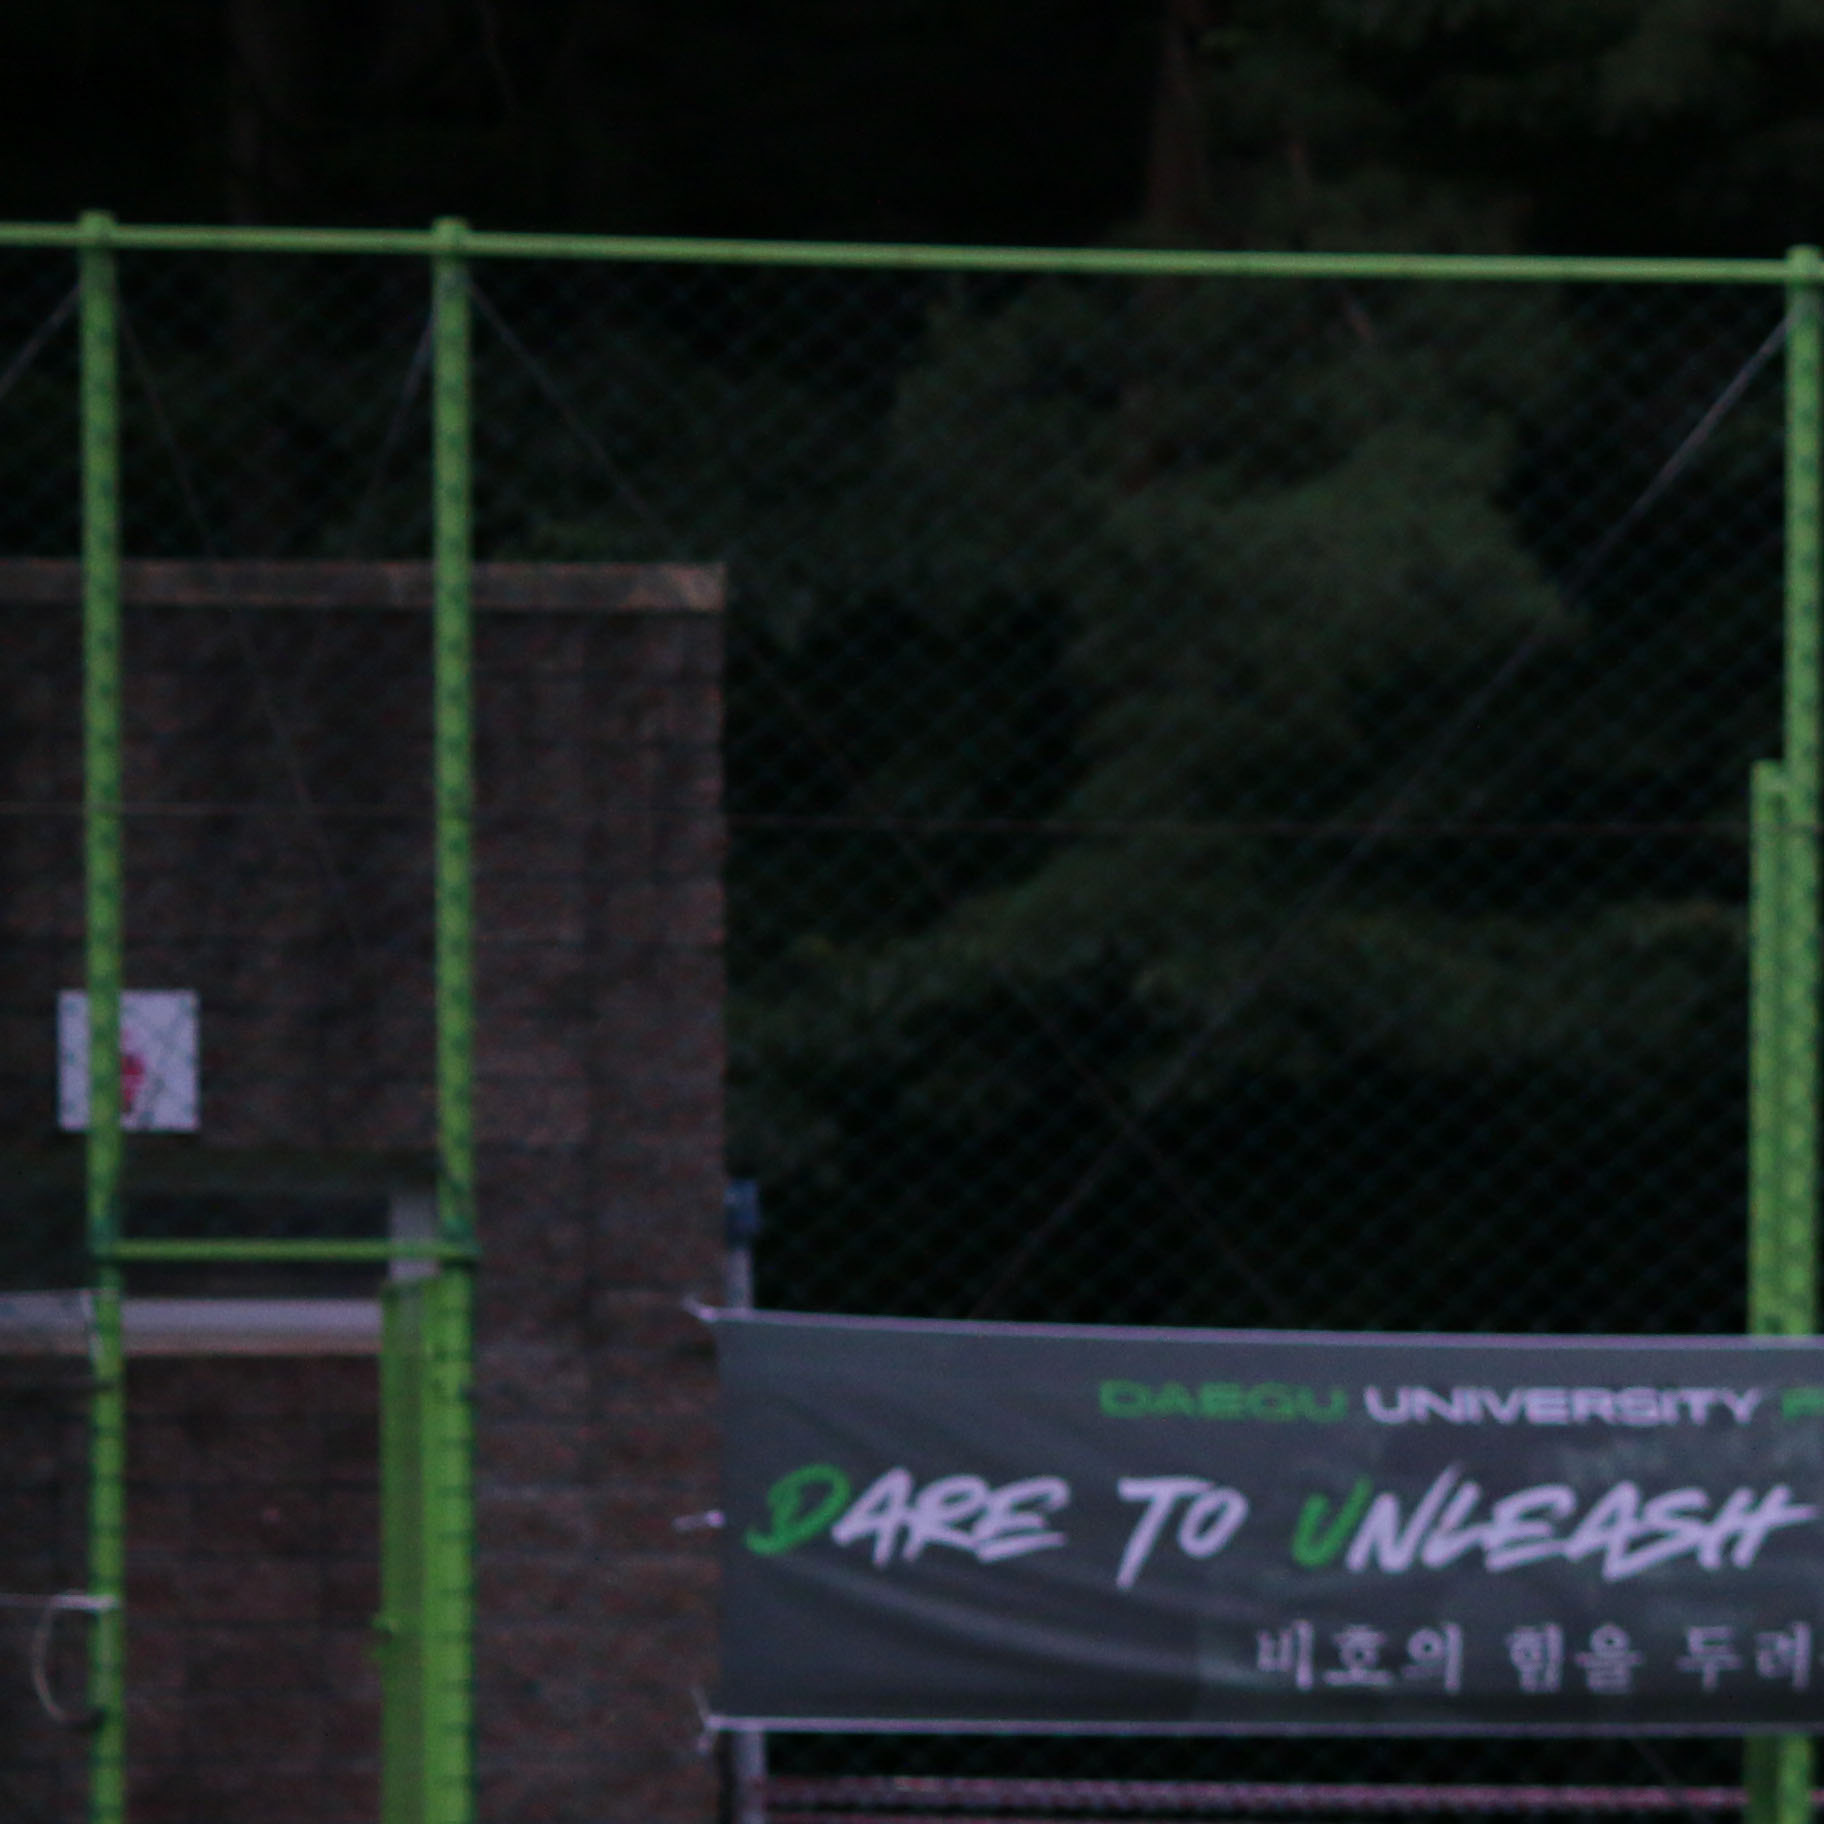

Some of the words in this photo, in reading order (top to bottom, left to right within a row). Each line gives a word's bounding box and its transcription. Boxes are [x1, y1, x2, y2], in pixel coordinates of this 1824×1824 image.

[1098, 1378, 1350, 1422] DAEGU
[1363, 1384, 1762, 1428] UNIVERSITY
[746, 1463, 1070, 1568] DARE
[1115, 1476, 1251, 1591] TO
[1256, 1619, 1464, 1695] 비호의
[1504, 1621, 1648, 1695] 힘을
